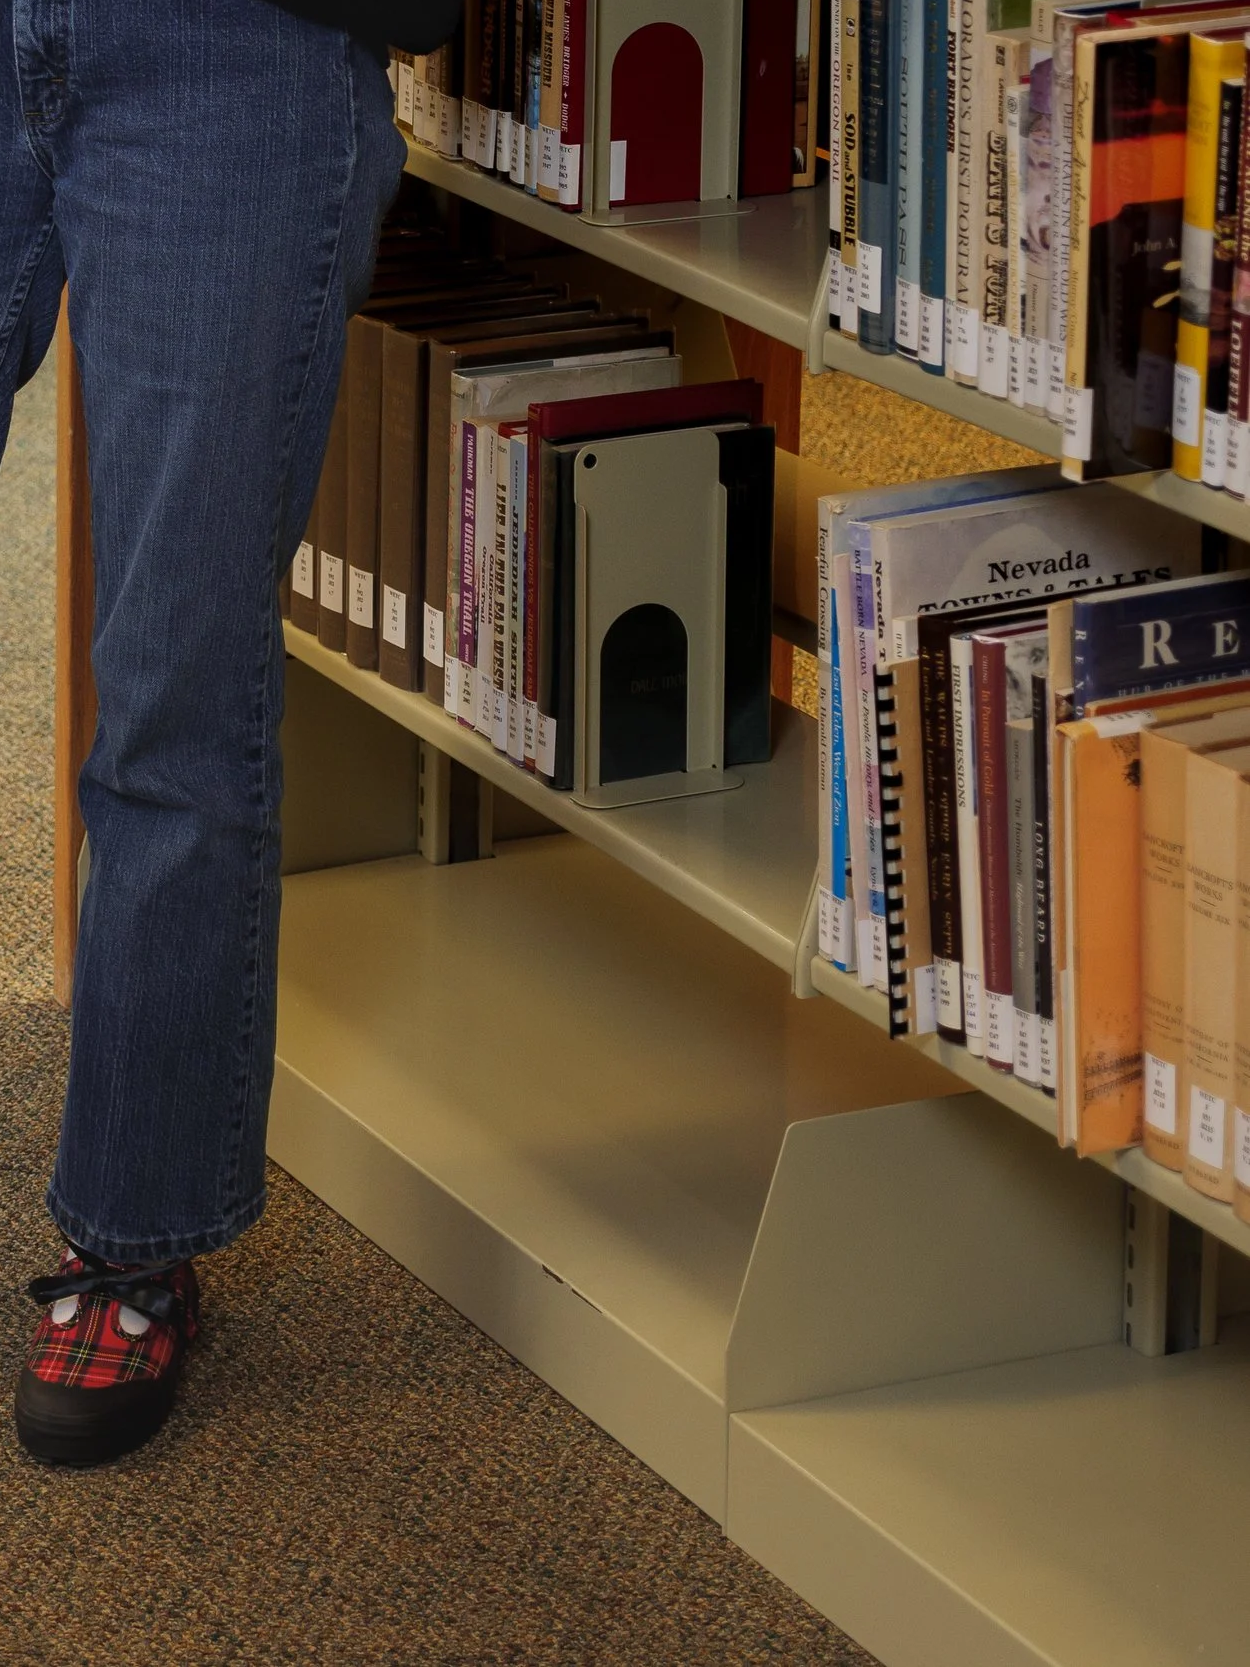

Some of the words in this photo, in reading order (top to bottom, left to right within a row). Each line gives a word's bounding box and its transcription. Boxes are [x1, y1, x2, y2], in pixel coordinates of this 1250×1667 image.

[543, 31, 553, 88] MISSOURI
[562, 45, 571, 87] BRIDGER
[946, 29, 957, 76] FORT
[561, 103, 569, 132] DODGE
[833, 60, 841, 134] OREGON
[899, 56, 909, 175] SOUTH
[946, 78, 956, 153] BRIDGER
[542, 127, 555, 136] WETC
[845, 112, 855, 151] SOD
[1063, 103, 1073, 145] DEEP
[832, 137, 840, 183] TRAIL
[959, 130, 970, 194] FIRST
[1062, 151, 1072, 207] TRAILS
[845, 172, 855, 247] STUBBLE
[986, 131, 1008, 248] BENT'S
[898, 185, 907, 265] PASS
[1061, 232, 1071, 266] THE
[1132, 239, 1162, 256] John
[1060, 269, 1069, 304] OLD
[466, 434, 474, 481] PARKMAN
[465, 487, 474, 520] THE
[496, 483, 506, 526] LIFE
[463, 522, 474, 587] OREGON
[496, 532, 506, 555] IN
[511, 505, 519, 622] JEDEDIAH
[819, 526, 828, 581] Fearful
[494, 558, 505, 596] THE
[854, 549, 862, 593] BATTLE
[987, 550, 1091, 584] Nevada
[462, 591, 472, 636] TRAIL
[494, 601, 504, 635] FAR
[818, 586, 829, 650] Crossing
[856, 596, 864, 627] BORN
[875, 560, 885, 639] Nevada
[493, 639, 504, 692] WEST
[858, 631, 867, 676] NEVADA
[1074, 629, 1087, 718] RENO
[832, 666, 840, 695] East
[953, 664, 961, 705] FIRST
[981, 705, 992, 747] Pursuit
[833, 751, 841, 779] West
[927, 748, 936, 796] Lander
[954, 709, 966, 808] IMPRESSIONS
[984, 765, 995, 795] Gold
[834, 799, 842, 826] Zion
[868, 815, 877, 853] Stories
[1035, 820, 1044, 869] LONG
[1036, 879, 1045, 943] BEARD
[1194, 881, 1223, 903] WORKS
[1199, 1090, 1216, 1103] WETC
